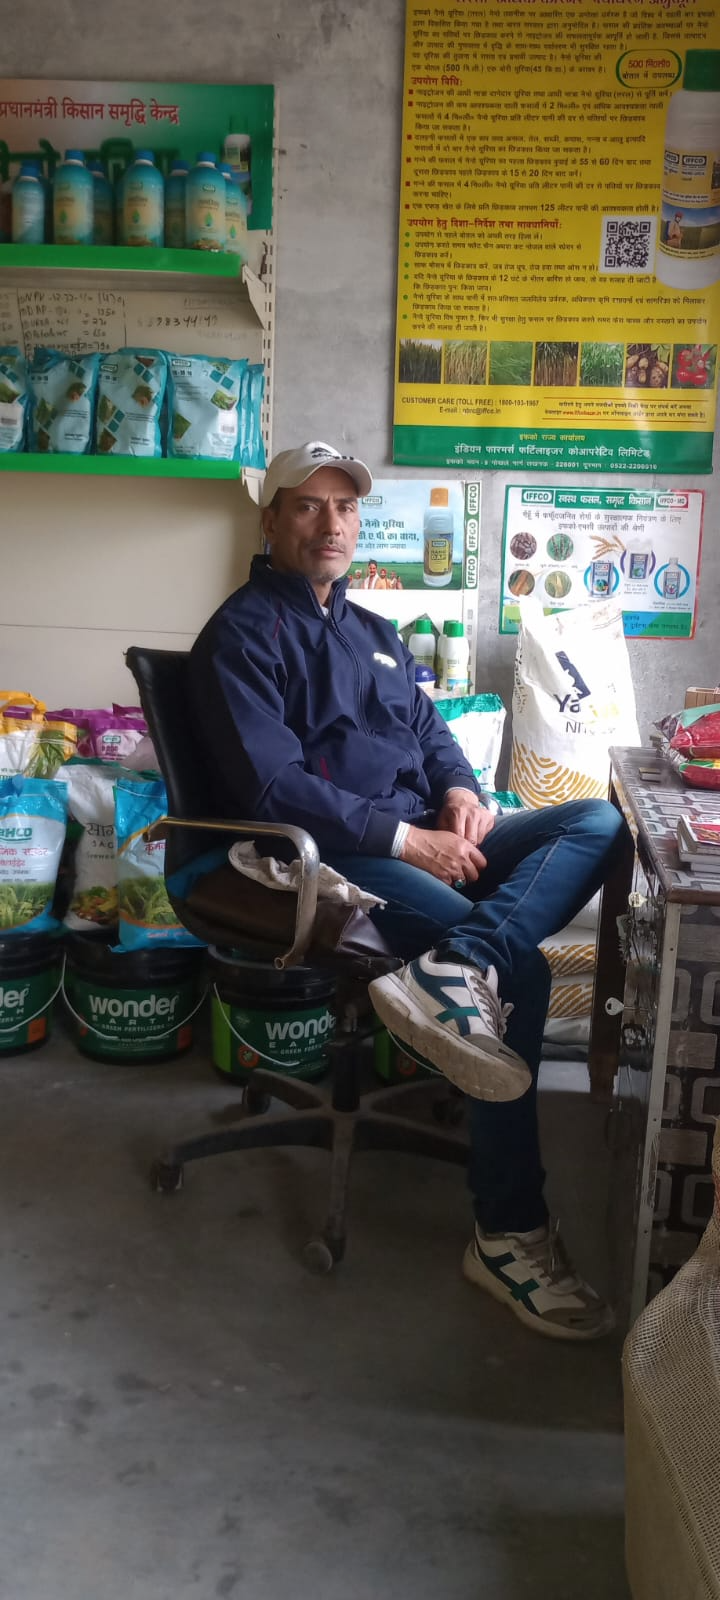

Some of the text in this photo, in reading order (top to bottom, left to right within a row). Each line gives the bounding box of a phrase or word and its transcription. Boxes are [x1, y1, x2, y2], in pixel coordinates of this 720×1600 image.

[628, 60, 643, 68] 500
[410, 75, 437, 86] उपयोग
[62, 97, 104, 120] किसान
[108, 98, 146, 126] समृद्धि
[150, 98, 180, 126] केन्द्र
[510, 168, 519, 176] 15
[529, 168, 539, 176] 20
[540, 203, 555, 211] 125
[406, 218, 433, 228] उपयोग
[498, 219, 514, 228] तथा
[401, 396, 436, 404] CUSTOMER
[437, 397, 454, 405] CARE
[456, 398, 474, 406] (TOLL
[475, 398, 494, 406] FREE)
[454, 442, 481, 454] इंडियन
[485, 443, 514, 455] फारमर्स
[469, 485, 477, 511] IFFCO
[526, 491, 549, 501] IFFCO
[387, 532, 397, 541] का
[469, 522, 477, 548] IFFCO
[468, 558, 476, 584] IFFCO
[88, 994, 180, 1018] wonder
